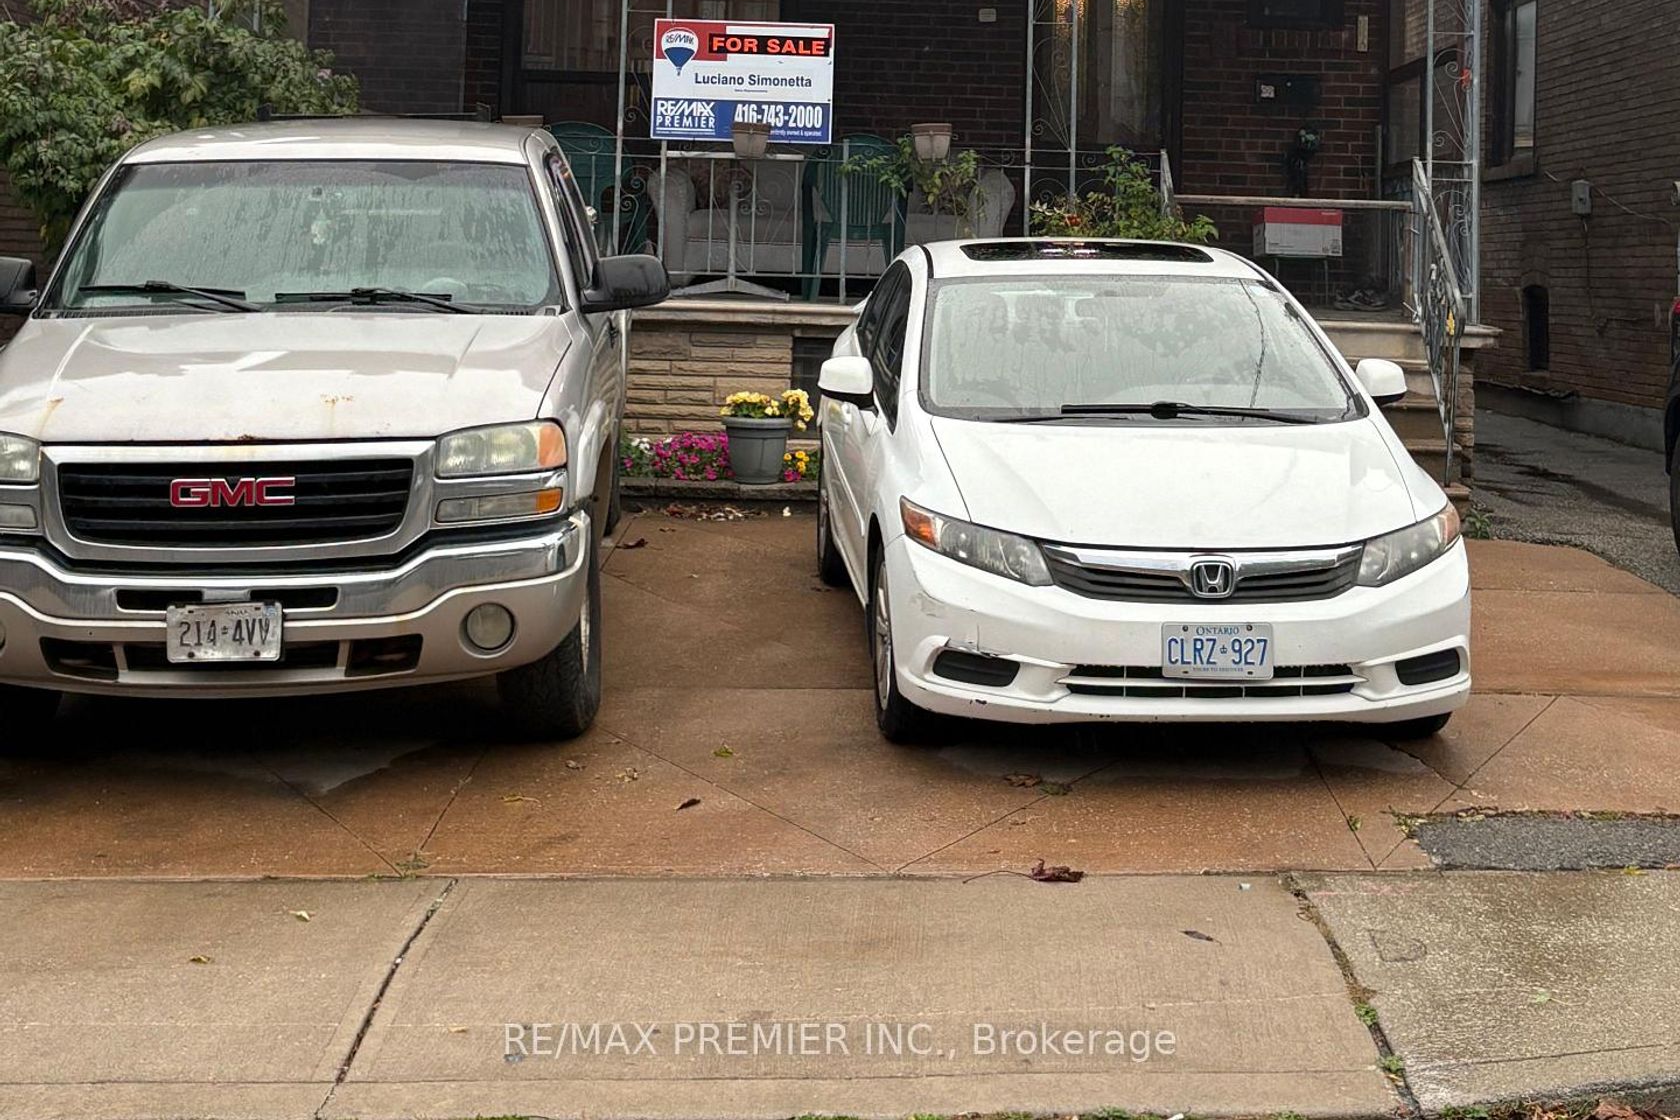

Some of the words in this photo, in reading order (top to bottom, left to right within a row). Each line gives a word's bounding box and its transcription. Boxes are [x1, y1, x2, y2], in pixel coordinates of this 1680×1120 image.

[712, 37, 758, 52] FOR
[767, 38, 825, 54] SALE
[694, 72, 745, 86] Luciano
[748, 73, 812, 87] Simonetta
[656, 99, 716, 117] RE/MAX
[734, 103, 823, 129] 416-743-2000
[656, 116, 716, 129] PREMIER
[170, 476, 296, 507] GMC
[179, 618, 217, 648] 214
[1196, 626, 1240, 636] ONTARIO
[1167, 637, 1217, 665] CLRZ
[1231, 638, 1269, 666] 927
